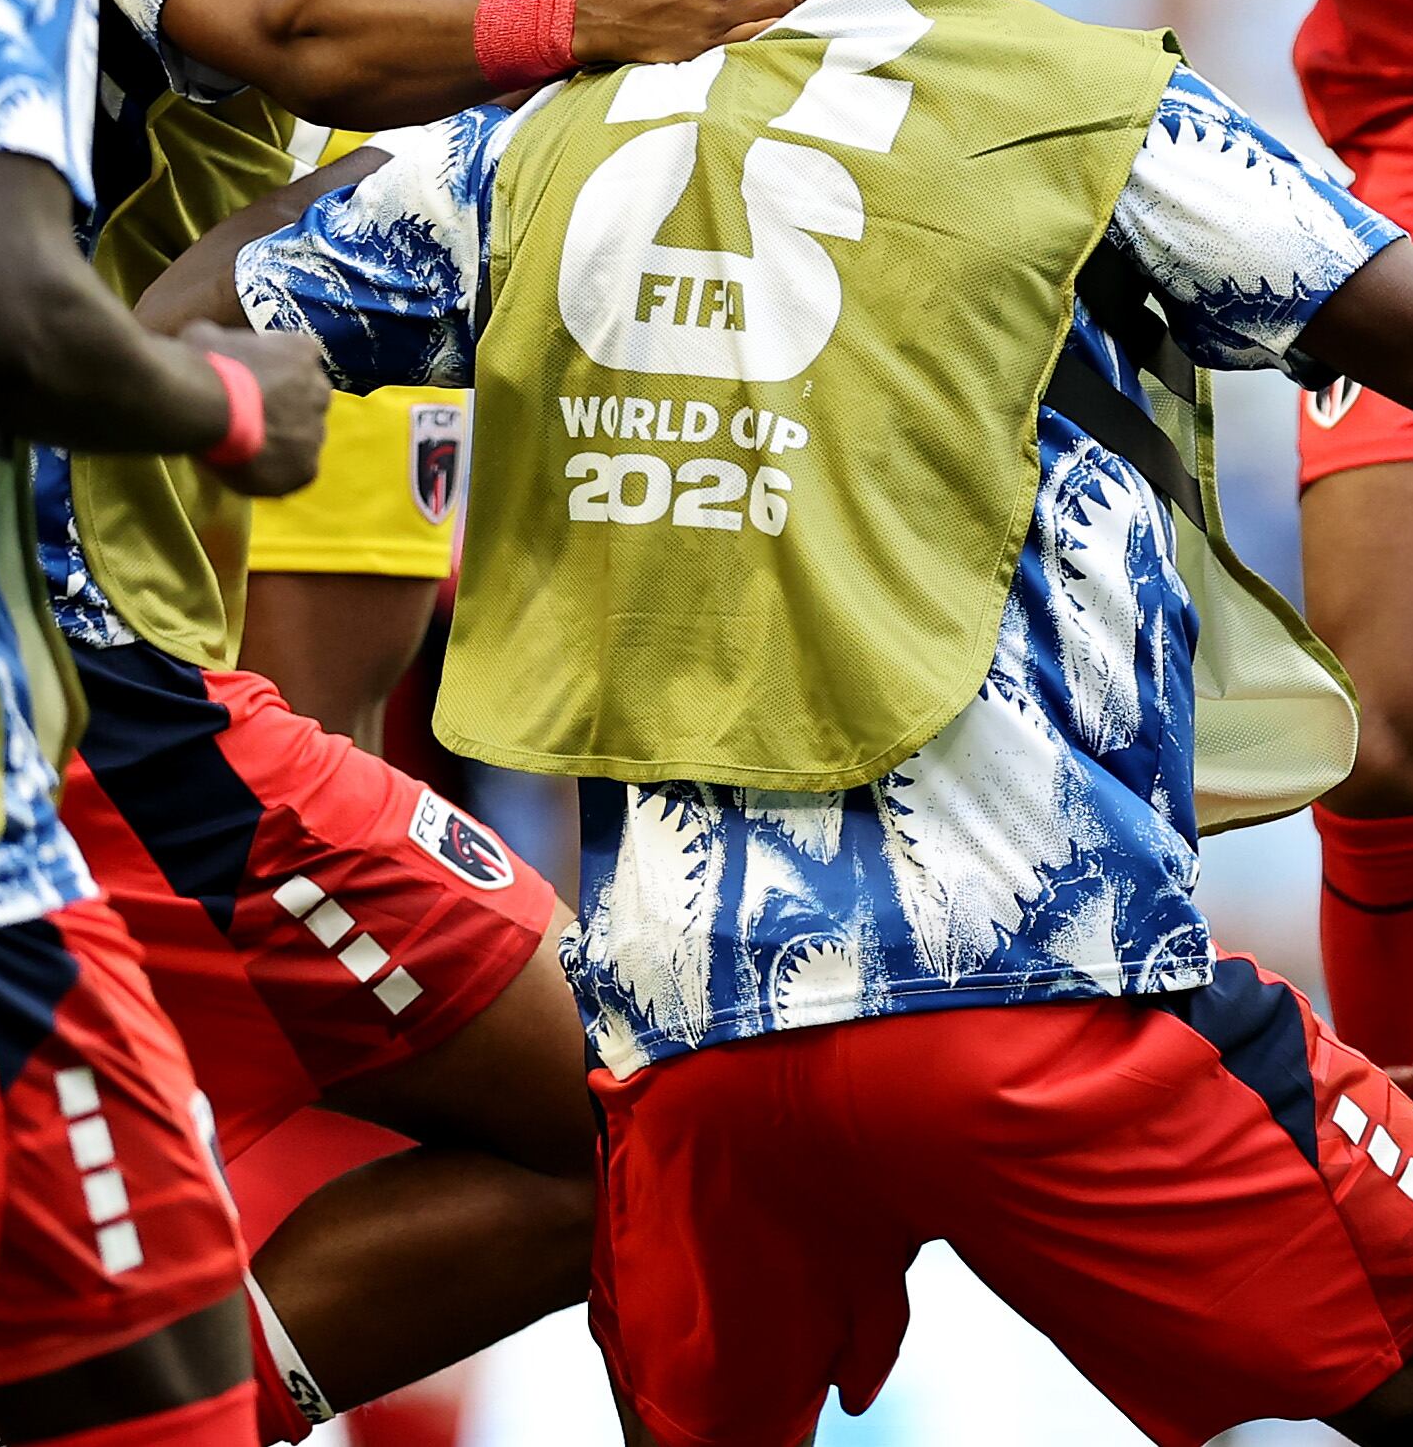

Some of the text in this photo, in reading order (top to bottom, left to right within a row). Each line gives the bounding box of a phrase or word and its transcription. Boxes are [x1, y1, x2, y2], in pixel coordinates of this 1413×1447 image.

[634, 272, 747, 333] FIFA
[558, 396, 812, 455] WORLD CUP
[564, 452, 793, 537] 2026
